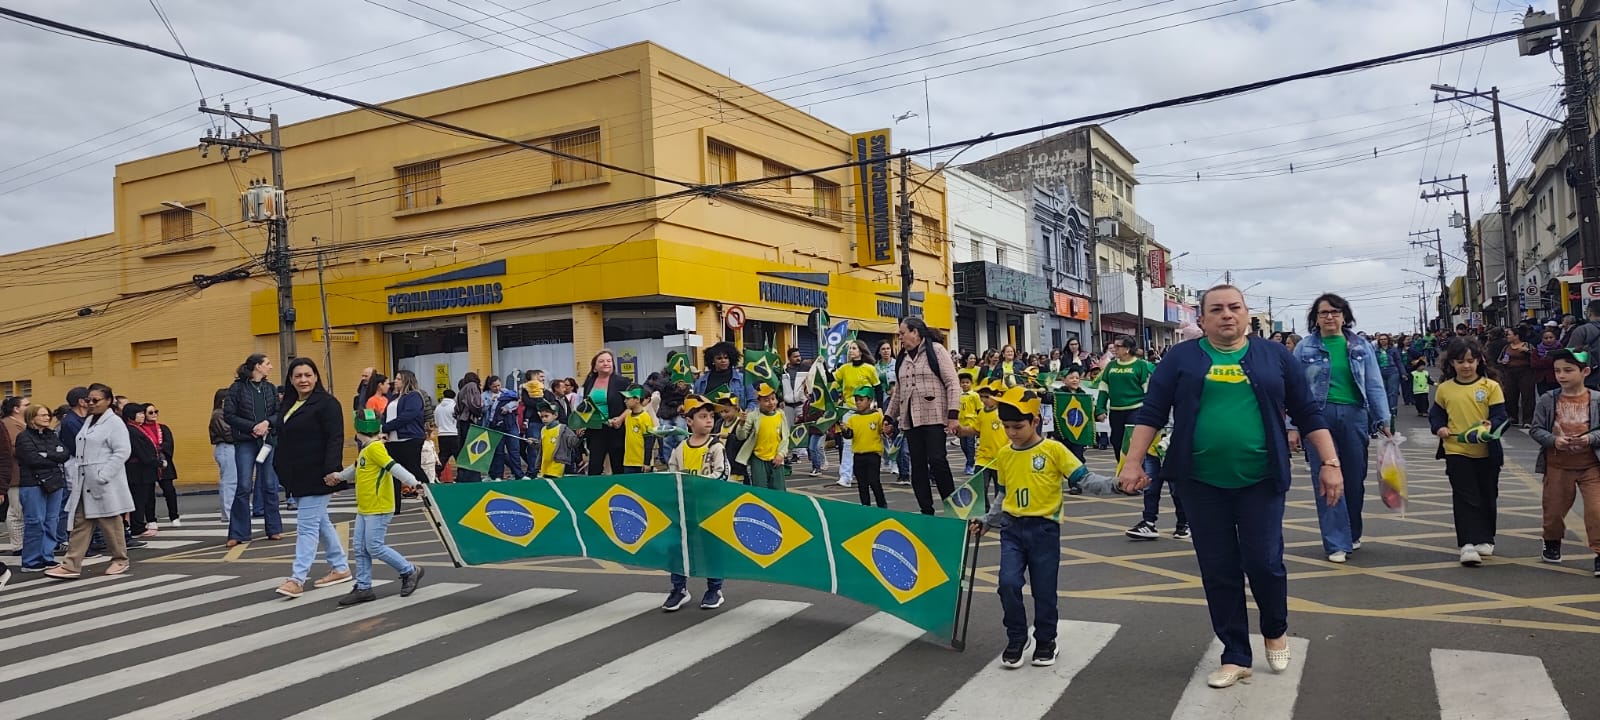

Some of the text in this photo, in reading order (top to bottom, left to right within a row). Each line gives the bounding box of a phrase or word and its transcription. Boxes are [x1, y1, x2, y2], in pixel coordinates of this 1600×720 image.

[870, 134, 890, 261] PERNAMBUCANAS
[388, 282, 503, 315] PERNAMBUCANAS
[759, 281, 828, 309] PERNAMBUCANAS
[1015, 487, 1028, 508] 10
